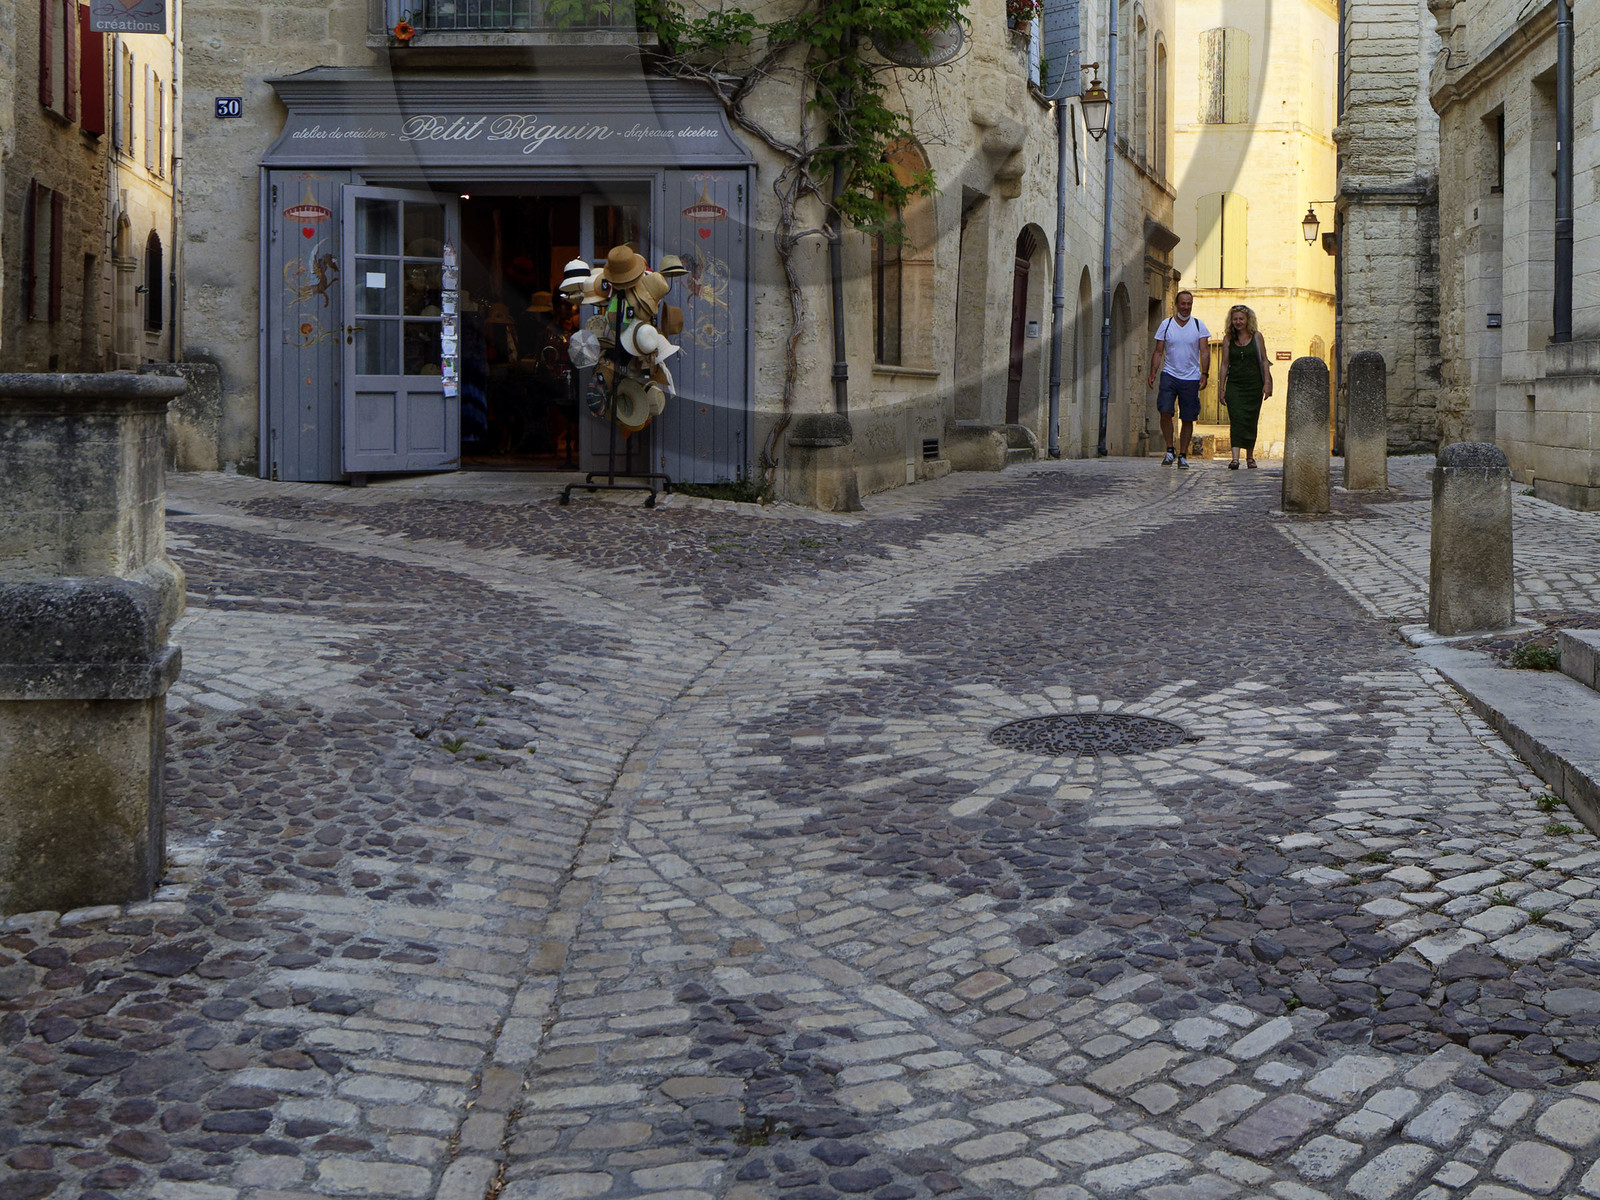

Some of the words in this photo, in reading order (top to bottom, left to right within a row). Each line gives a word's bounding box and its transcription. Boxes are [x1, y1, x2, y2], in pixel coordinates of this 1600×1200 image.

[96, 18, 160, 31] créations
[218, 100, 239, 115] 30
[292, 124, 328, 139] atelier
[328, 126, 343, 139] de
[343, 127, 388, 139] création
[399, 114, 488, 142] Petit
